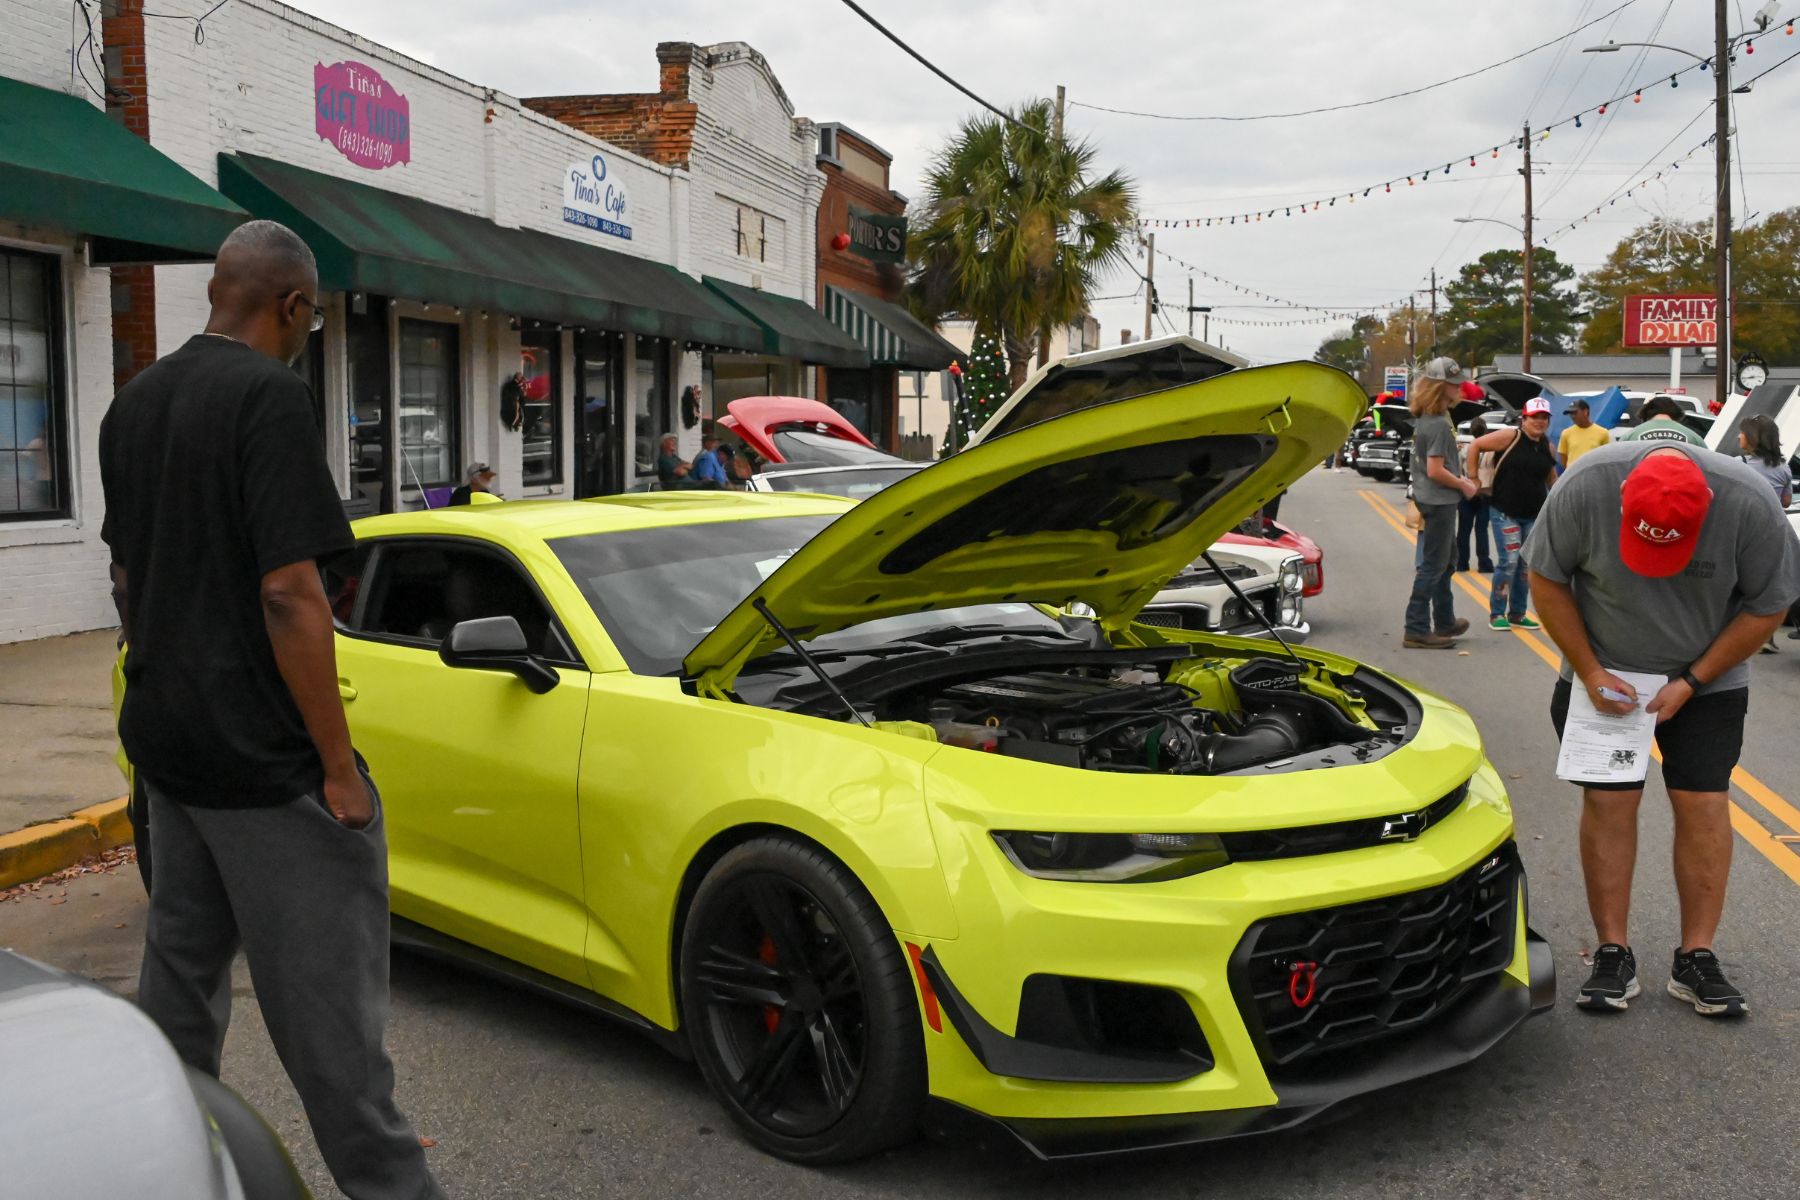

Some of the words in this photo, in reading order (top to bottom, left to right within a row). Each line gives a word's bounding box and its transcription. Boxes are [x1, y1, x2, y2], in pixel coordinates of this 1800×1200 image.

[347, 67, 382, 98] Tina's
[317, 84, 356, 129] GIFT
[367, 102, 408, 144] SHOP
[338, 126, 393, 163] (843)326-1090
[571, 170, 600, 205] Tina's
[605, 183, 625, 221] Café
[1640, 299, 1717, 321] FAMILY
[1640, 321, 1717, 343] DOLLAR
[1638, 518, 1680, 539] FCA
[1243, 674, 1297, 689] OTO-FAB
